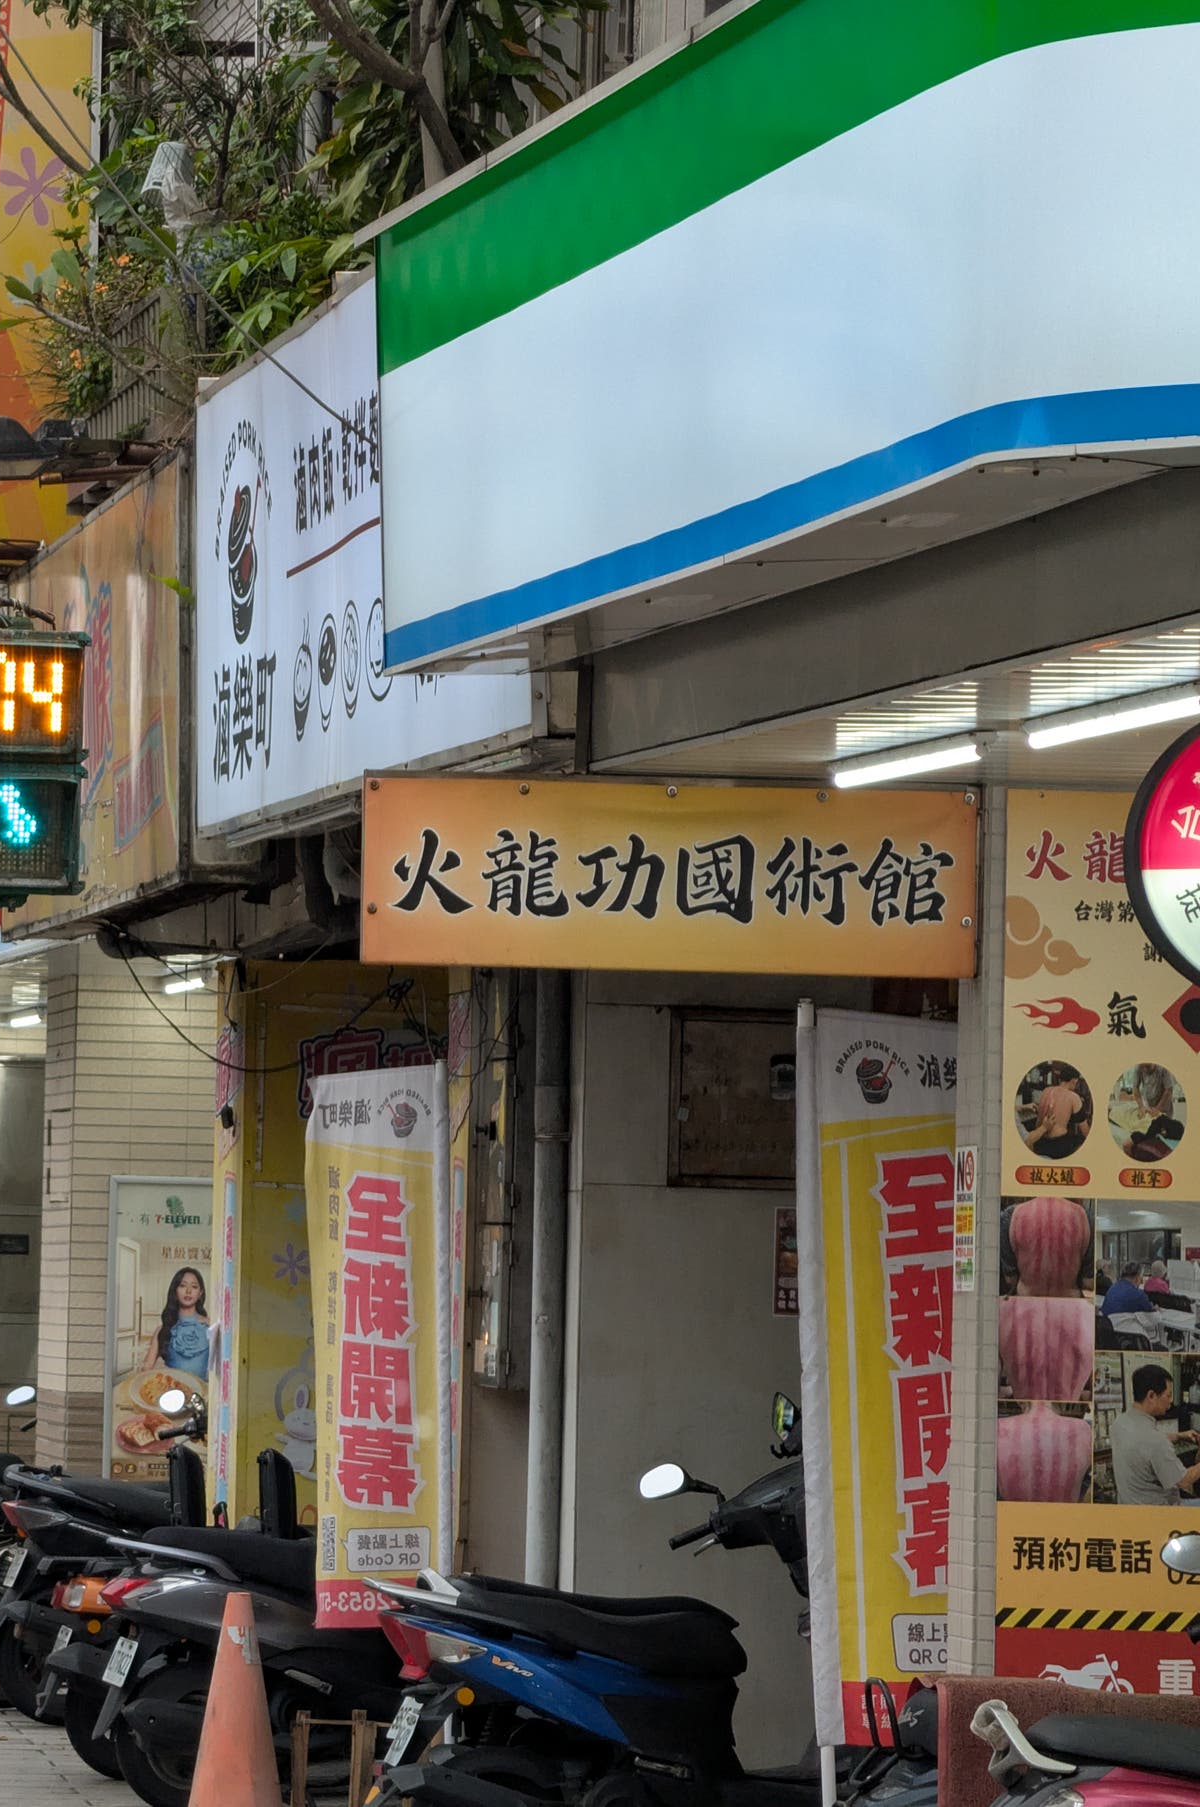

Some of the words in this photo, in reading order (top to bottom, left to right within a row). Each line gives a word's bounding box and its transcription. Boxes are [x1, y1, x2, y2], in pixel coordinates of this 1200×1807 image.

[1025, 830, 1125, 883] 火龍
[392, 828, 955, 926] 火龍功國術館
[1106, 992, 1146, 1039] 氣
[835, 1041, 863, 1075] BRAISED
[866, 1039, 890, 1055] PORK
[891, 1052, 910, 1077] RICE
[1013, 1536, 1153, 1574] 預約電話
[907, 1622, 948, 1644] 線上
[908, 1648, 933, 1666] QR
